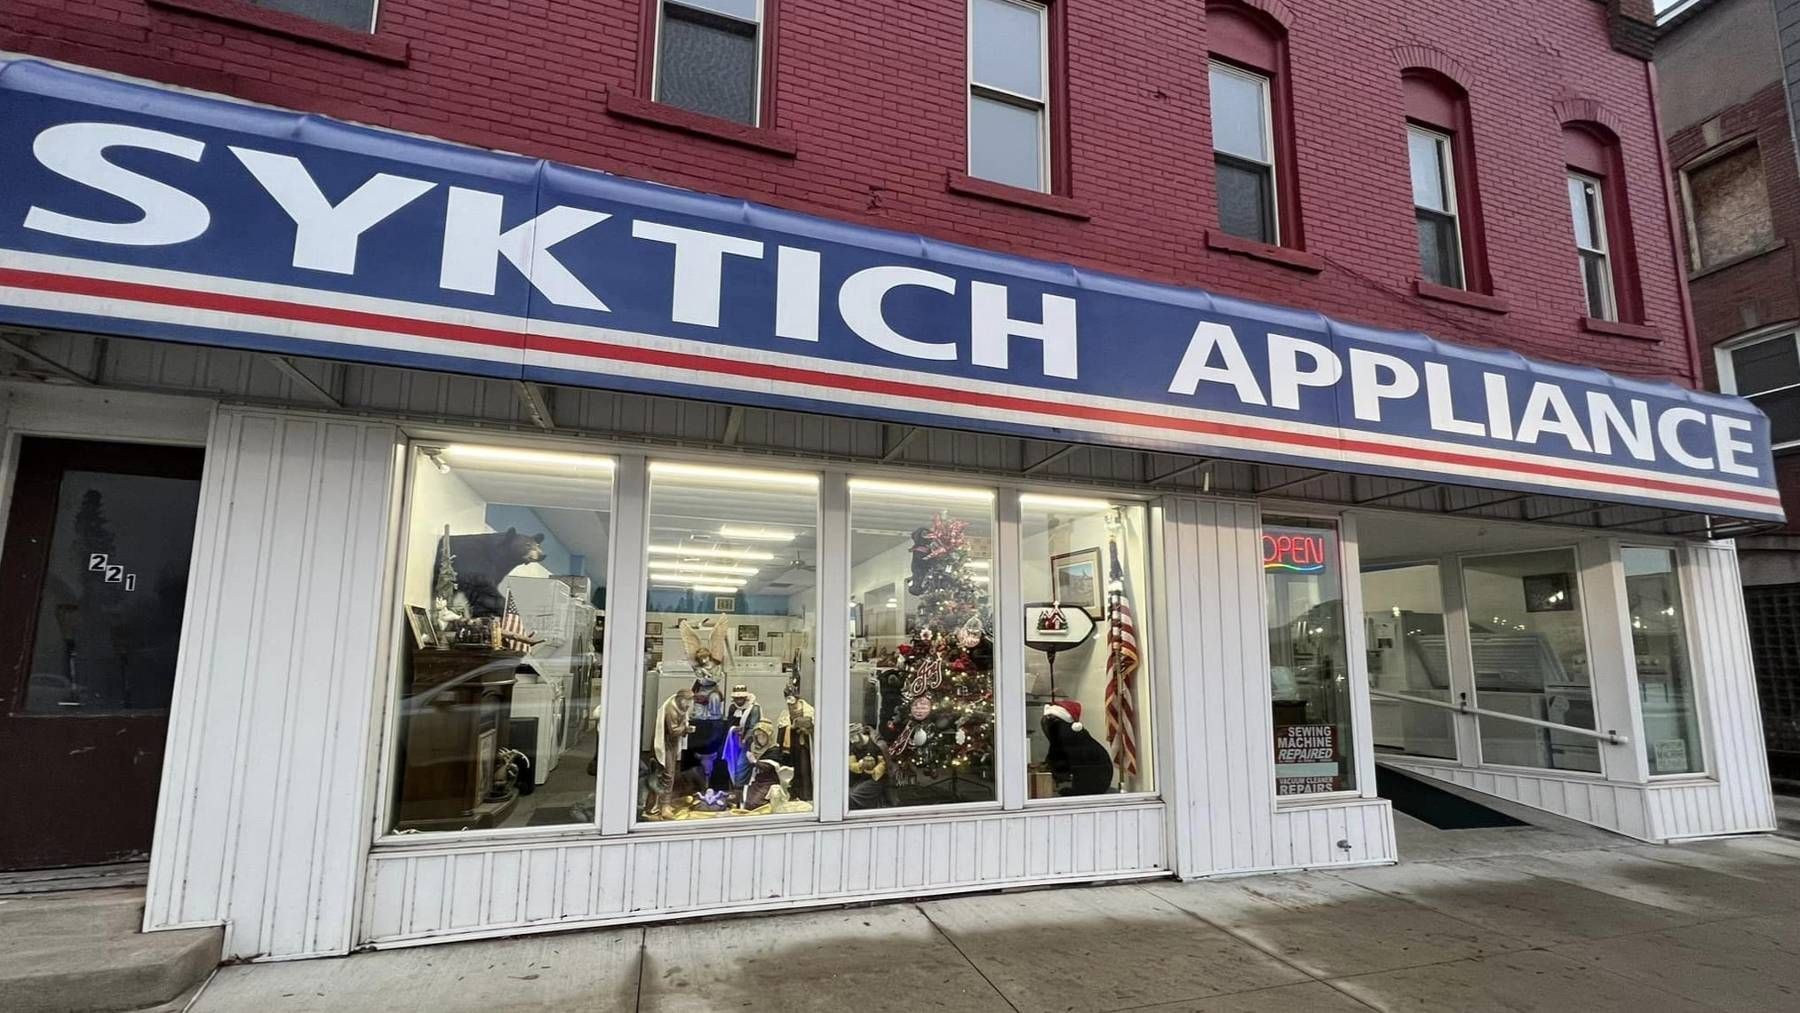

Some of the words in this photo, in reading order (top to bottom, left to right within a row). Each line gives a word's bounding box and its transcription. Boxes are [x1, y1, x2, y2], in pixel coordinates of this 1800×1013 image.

[22, 122, 1078, 380] SYKTICH
[1168, 320, 1760, 479] APPLIANCE
[1262, 535, 1323, 564] OPEN
[89, 553, 136, 591] 221
[1287, 726, 1332, 737] SEWING
[1277, 736, 1333, 749] MACHINE
[1278, 748, 1333, 760] REPAIRED
[1279, 783, 1334, 795] REPAIRS
